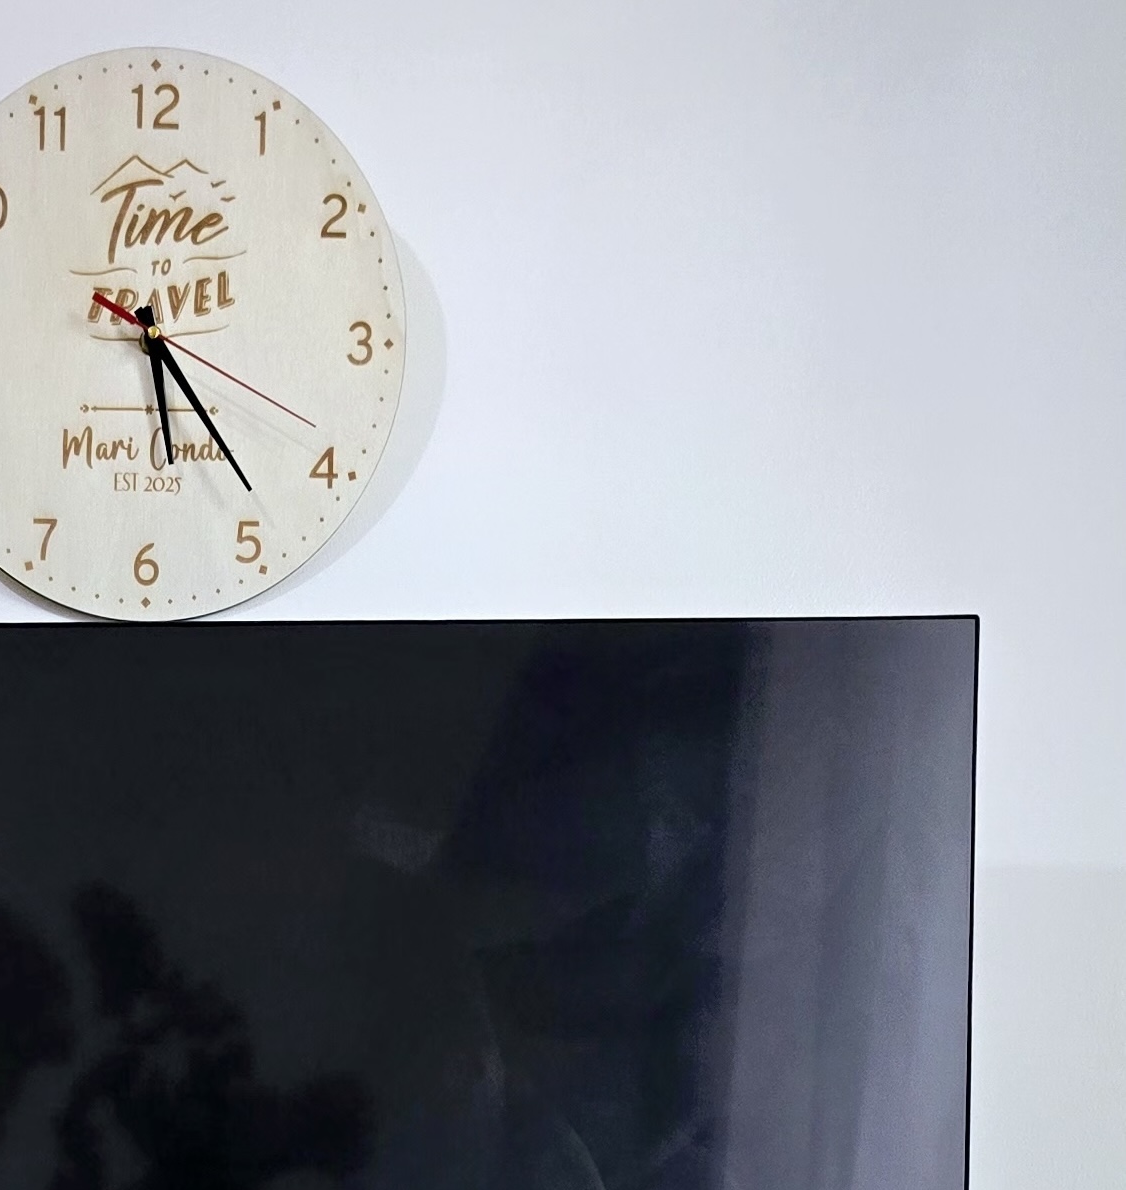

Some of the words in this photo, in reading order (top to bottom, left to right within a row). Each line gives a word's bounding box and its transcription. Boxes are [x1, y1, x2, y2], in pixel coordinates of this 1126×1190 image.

[33, 105, 68, 151] 11
[131, 83, 180, 130] 12
[253, 110, 268, 156] 1
[100, 178, 229, 265] Time
[320, 193, 348, 240] 2
[151, 258, 172, 277] TO
[87, 270, 236, 326] TRAVEL
[346, 321, 374, 367] 3
[62, 425, 140, 470] Mari
[309, 446, 339, 489] 4
[114, 471, 139, 492] EST
[143, 476, 183, 495] 2025
[32, 518, 58, 562] 7
[235, 521, 262, 564] 5
[133, 543, 160, 587] 6
